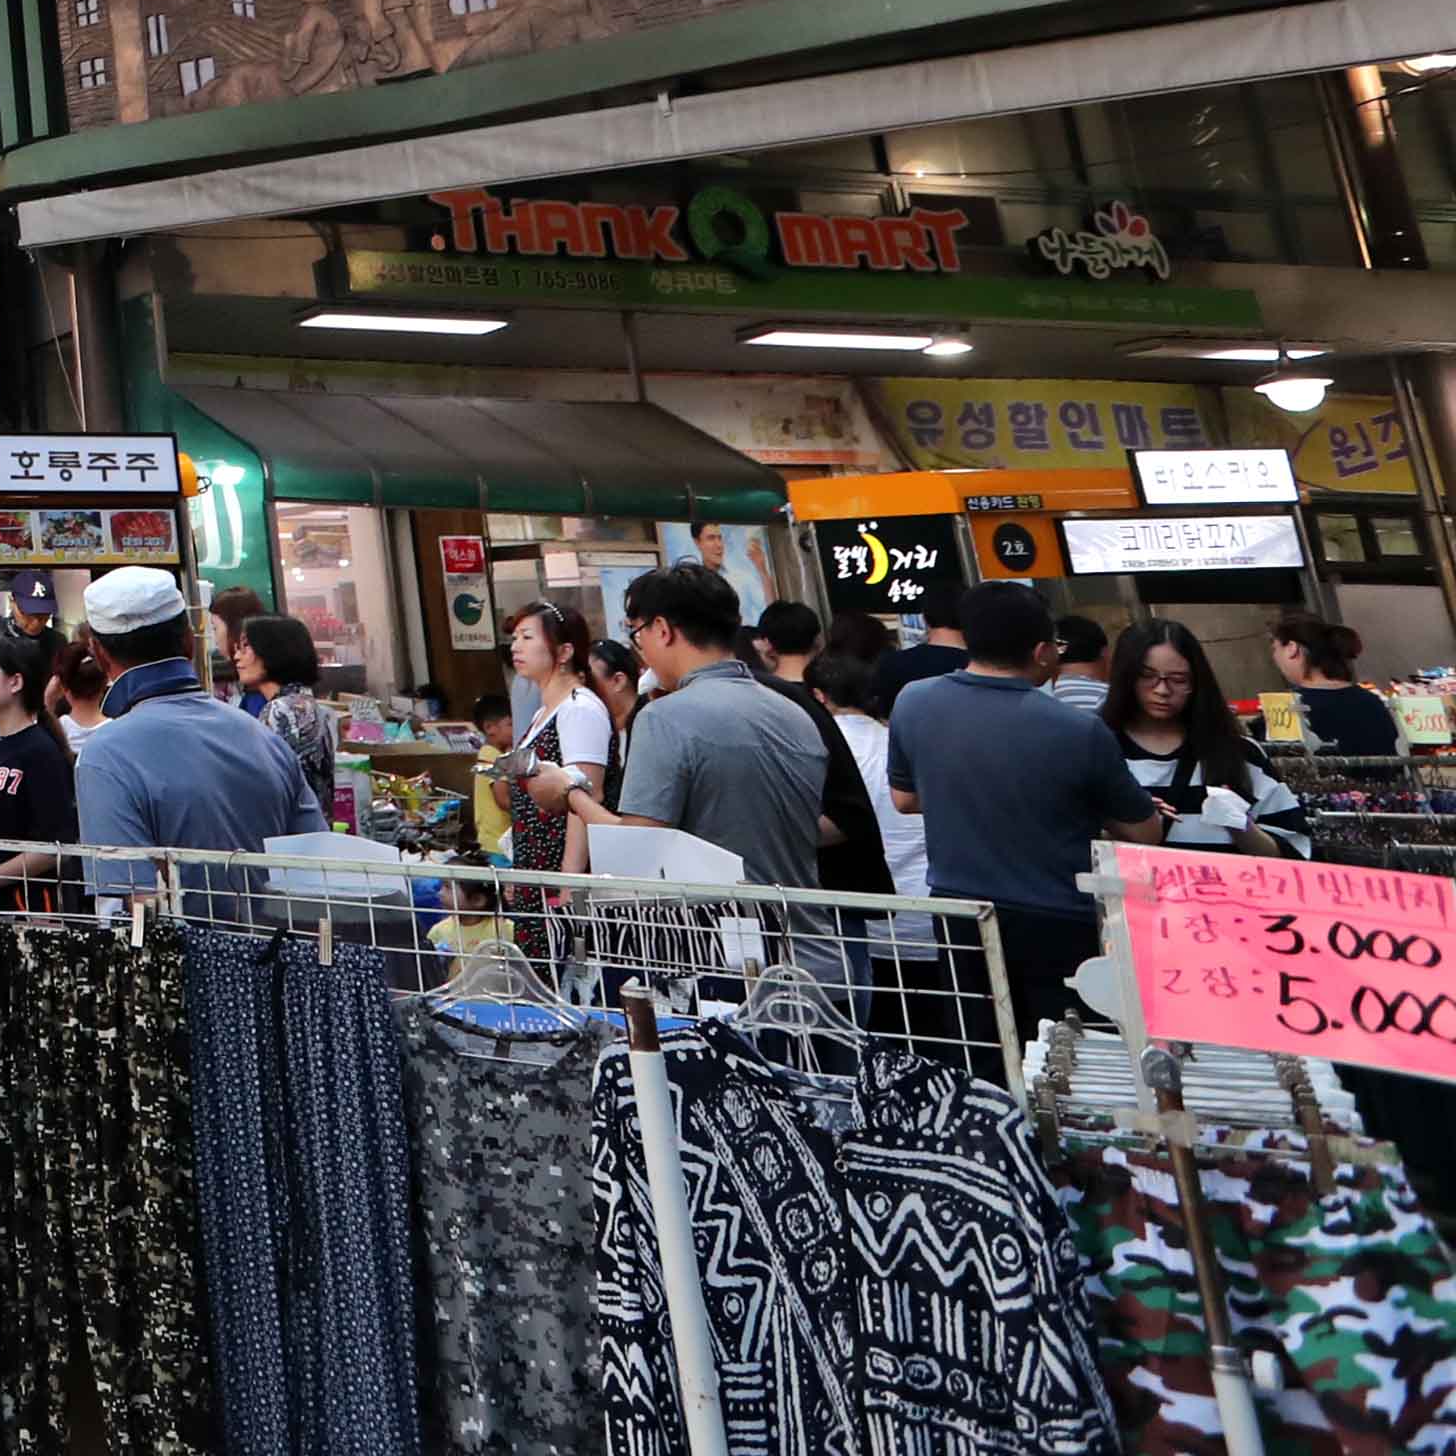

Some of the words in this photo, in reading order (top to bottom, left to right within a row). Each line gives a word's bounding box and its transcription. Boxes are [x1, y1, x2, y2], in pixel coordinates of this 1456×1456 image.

[429, 188, 689, 261] THANK
[775, 209, 970, 272] MART
[905, 399, 1201, 451] 유성할인마트
[10, 450, 159, 483] 호롱주주
[968, 497, 1015, 511] 신용카드
[1001, 540, 1030, 556] 2호
